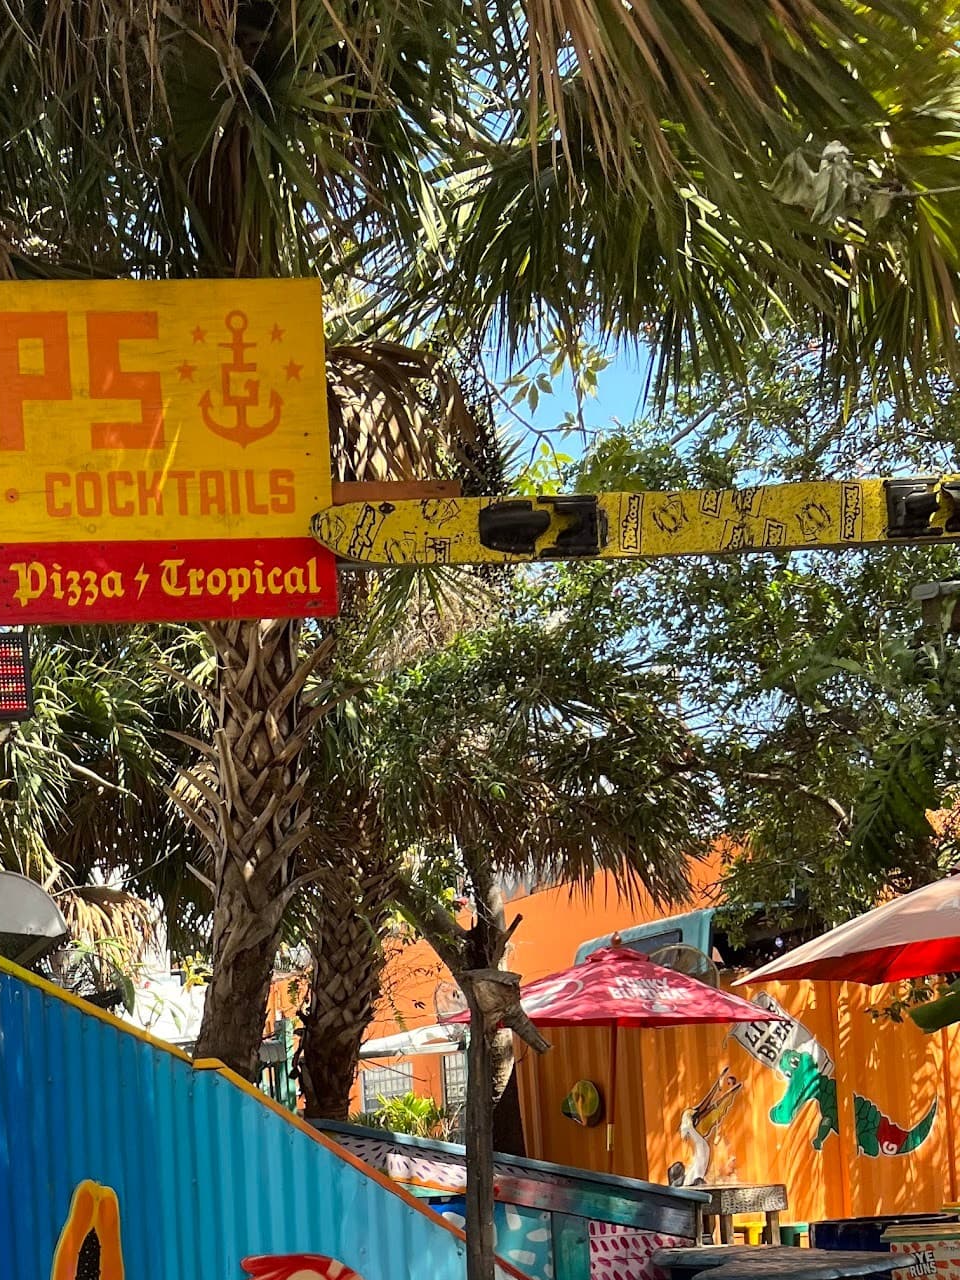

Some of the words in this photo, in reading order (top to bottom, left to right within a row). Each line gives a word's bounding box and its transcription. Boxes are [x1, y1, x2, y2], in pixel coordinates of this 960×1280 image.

[45, 469, 296, 518] COCKTAILS
[9, 560, 126, 608] Pizza
[159, 556, 321, 602] Tropical
[756, 1019, 794, 1063] BEER
[909, 1261, 937, 1278] RUNS
